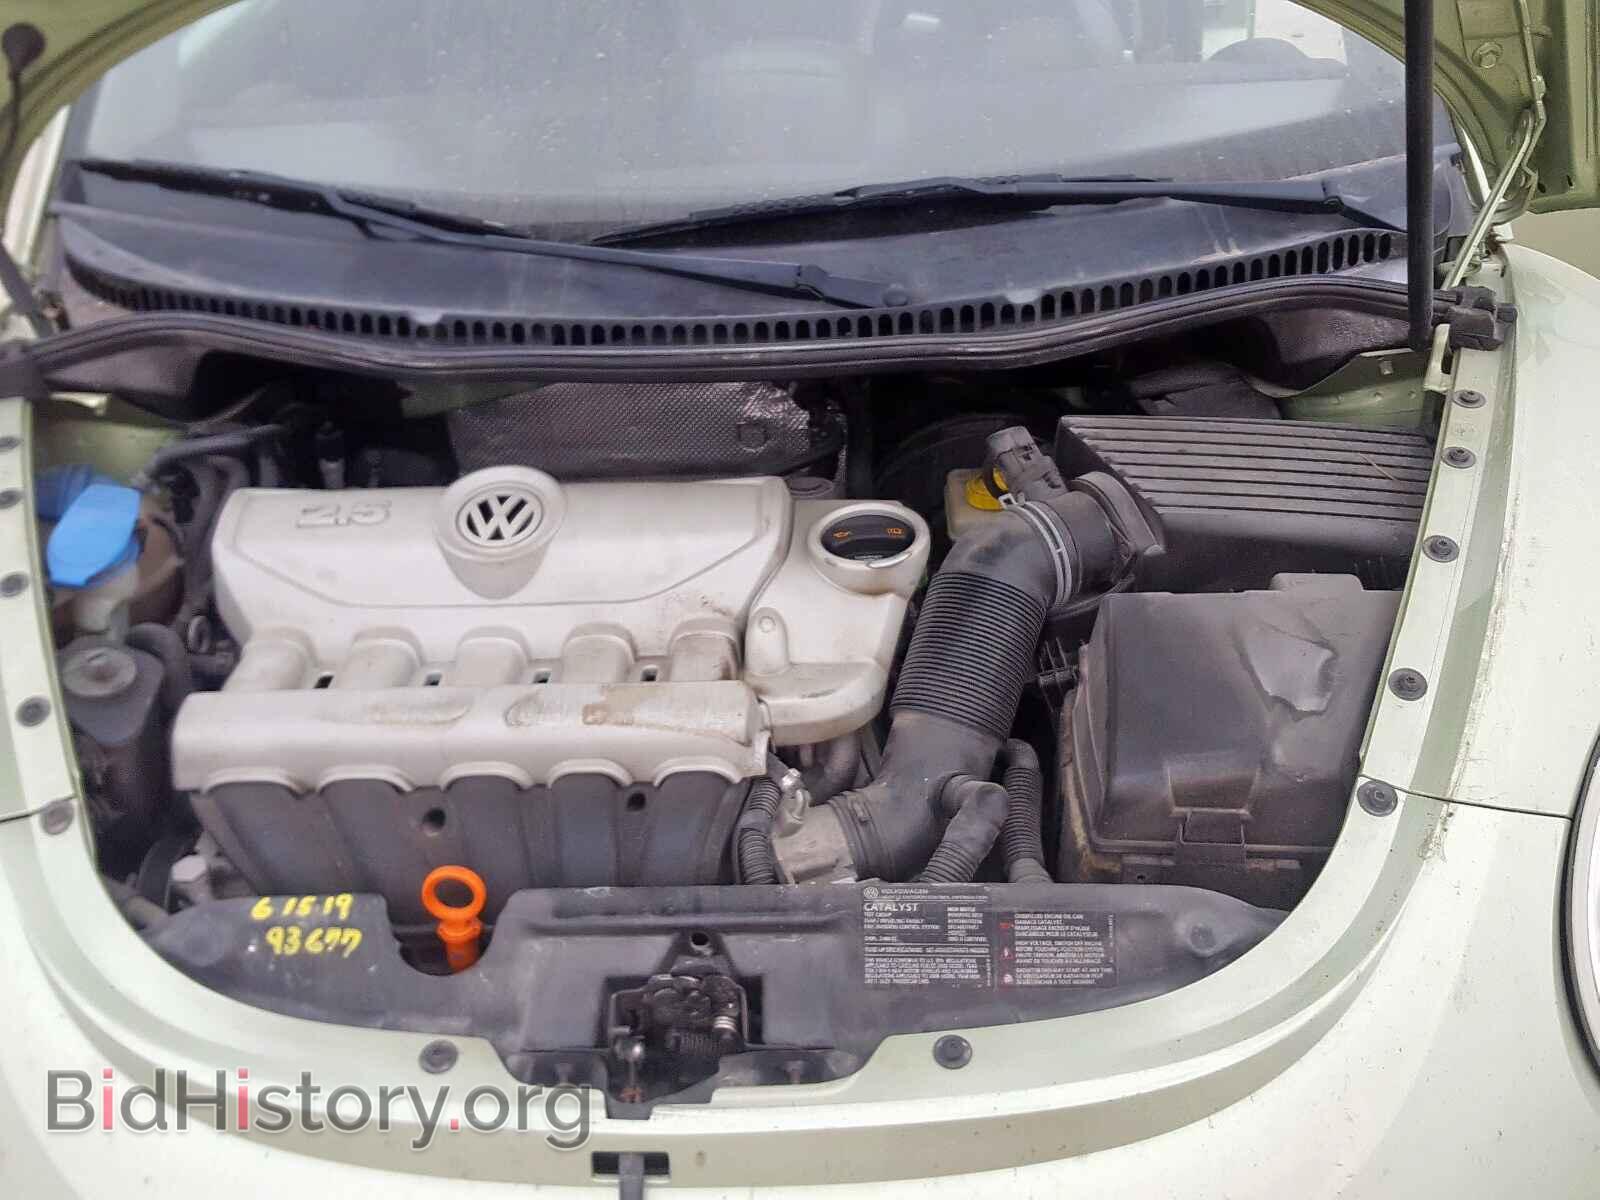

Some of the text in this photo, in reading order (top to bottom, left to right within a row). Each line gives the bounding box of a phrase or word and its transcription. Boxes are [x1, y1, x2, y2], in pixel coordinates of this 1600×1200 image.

[251, 896, 274, 920] 6
[323, 892, 353, 920] 19
[863, 902, 919, 912] CATALYST
